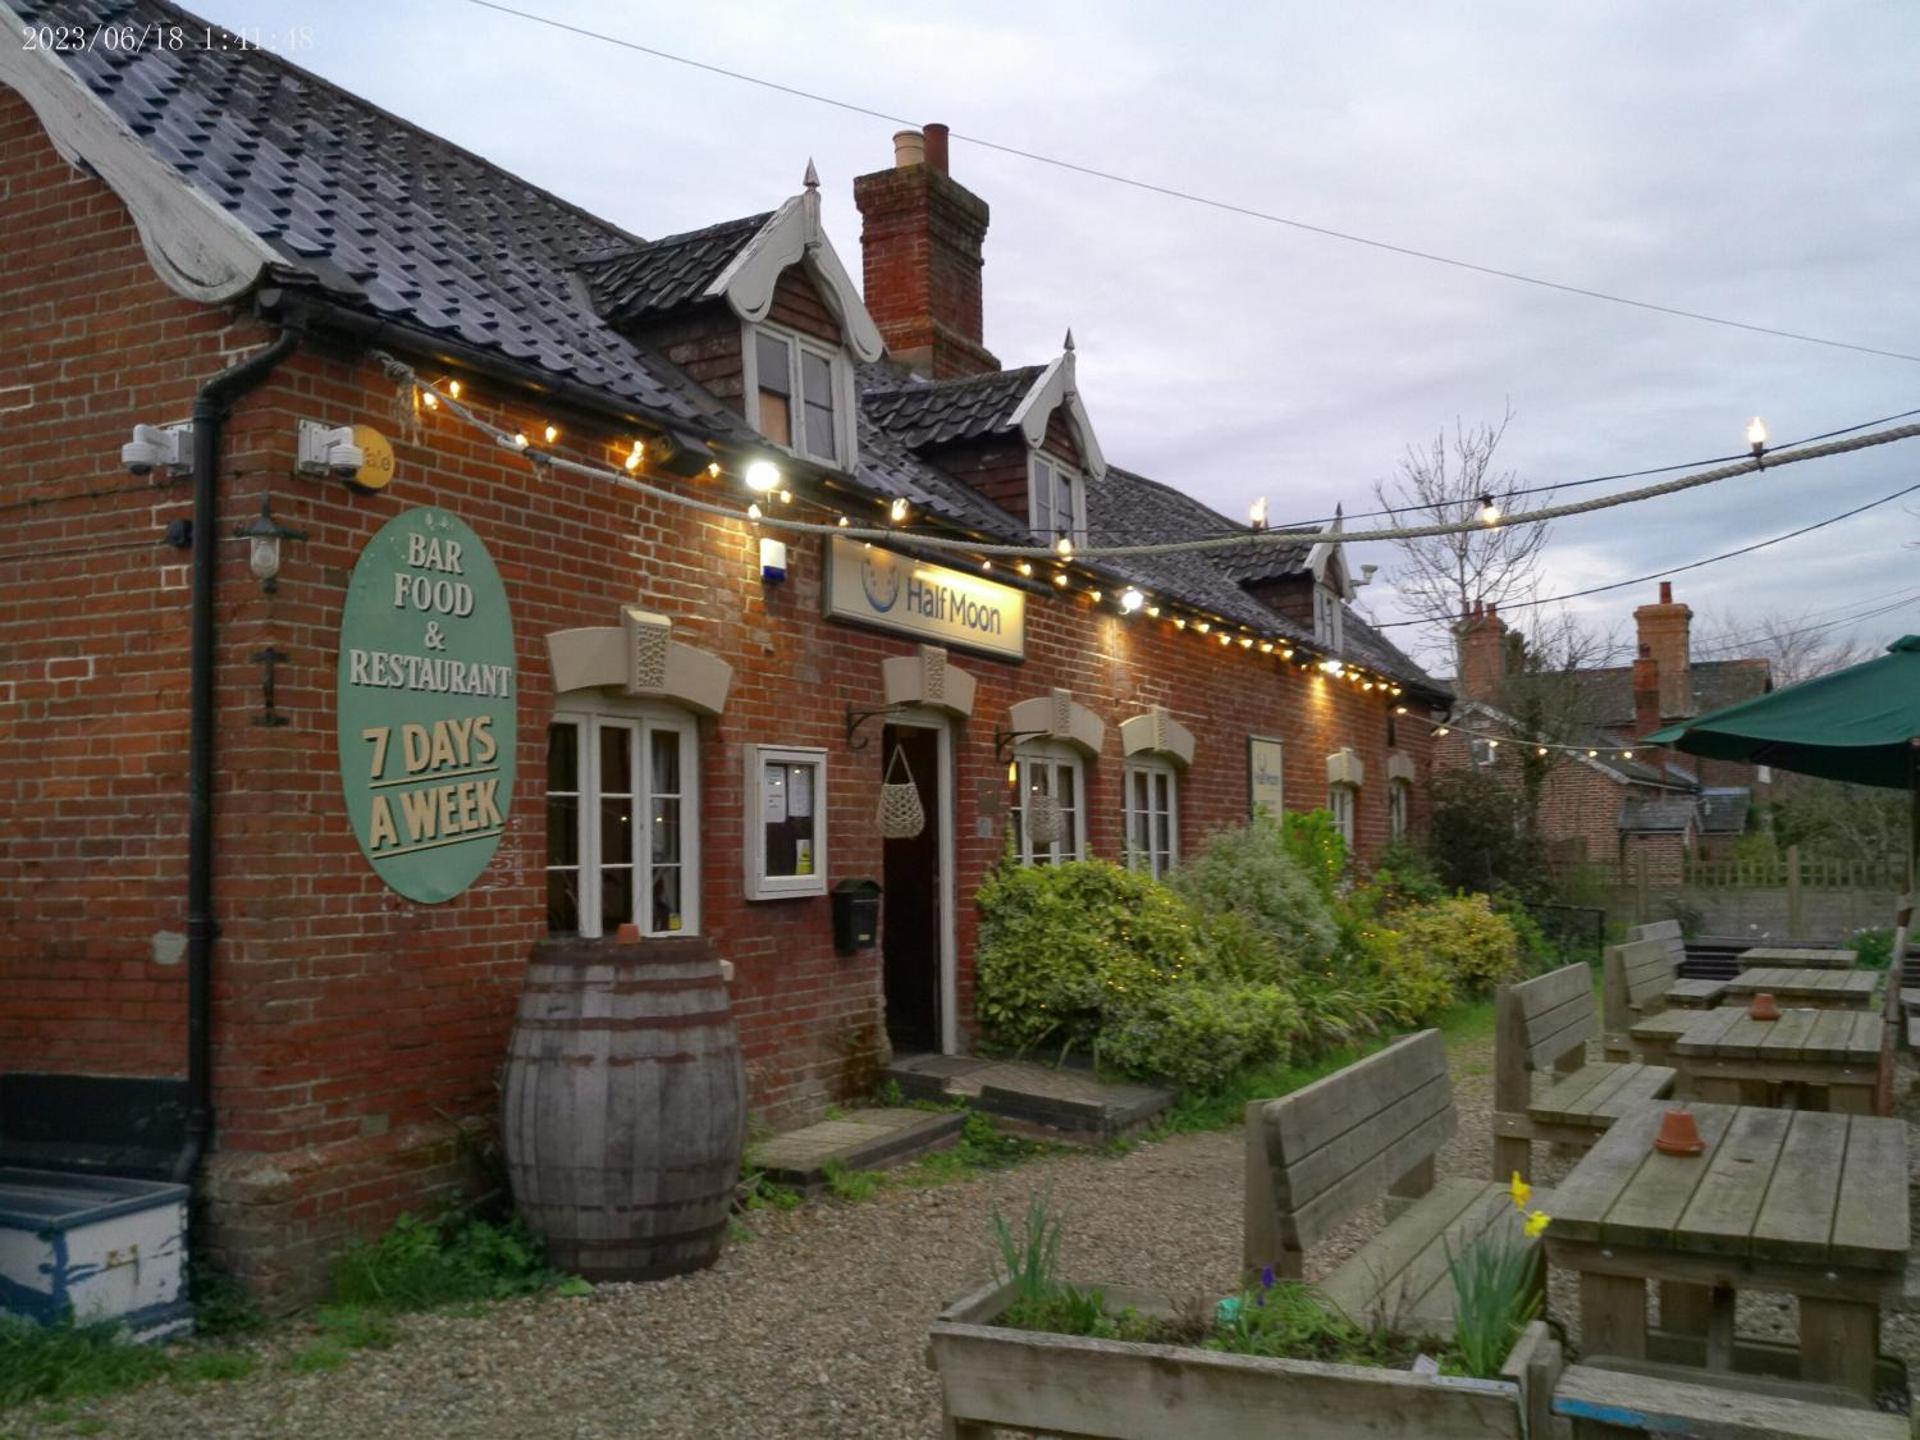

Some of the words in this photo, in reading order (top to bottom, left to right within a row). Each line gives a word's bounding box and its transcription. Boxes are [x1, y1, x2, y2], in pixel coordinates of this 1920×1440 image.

[408, 532, 463, 572] BAR
[394, 573, 473, 616] FOOD
[907, 577, 948, 619] Half
[949, 590, 1000, 635] Moon
[424, 621, 445, 649] &
[350, 649, 512, 697] RESTAURANT
[363, 726, 390, 778] 7
[402, 715, 497, 773] DAYS
[370, 795, 399, 849] A
[401, 779, 502, 843] WEEK
